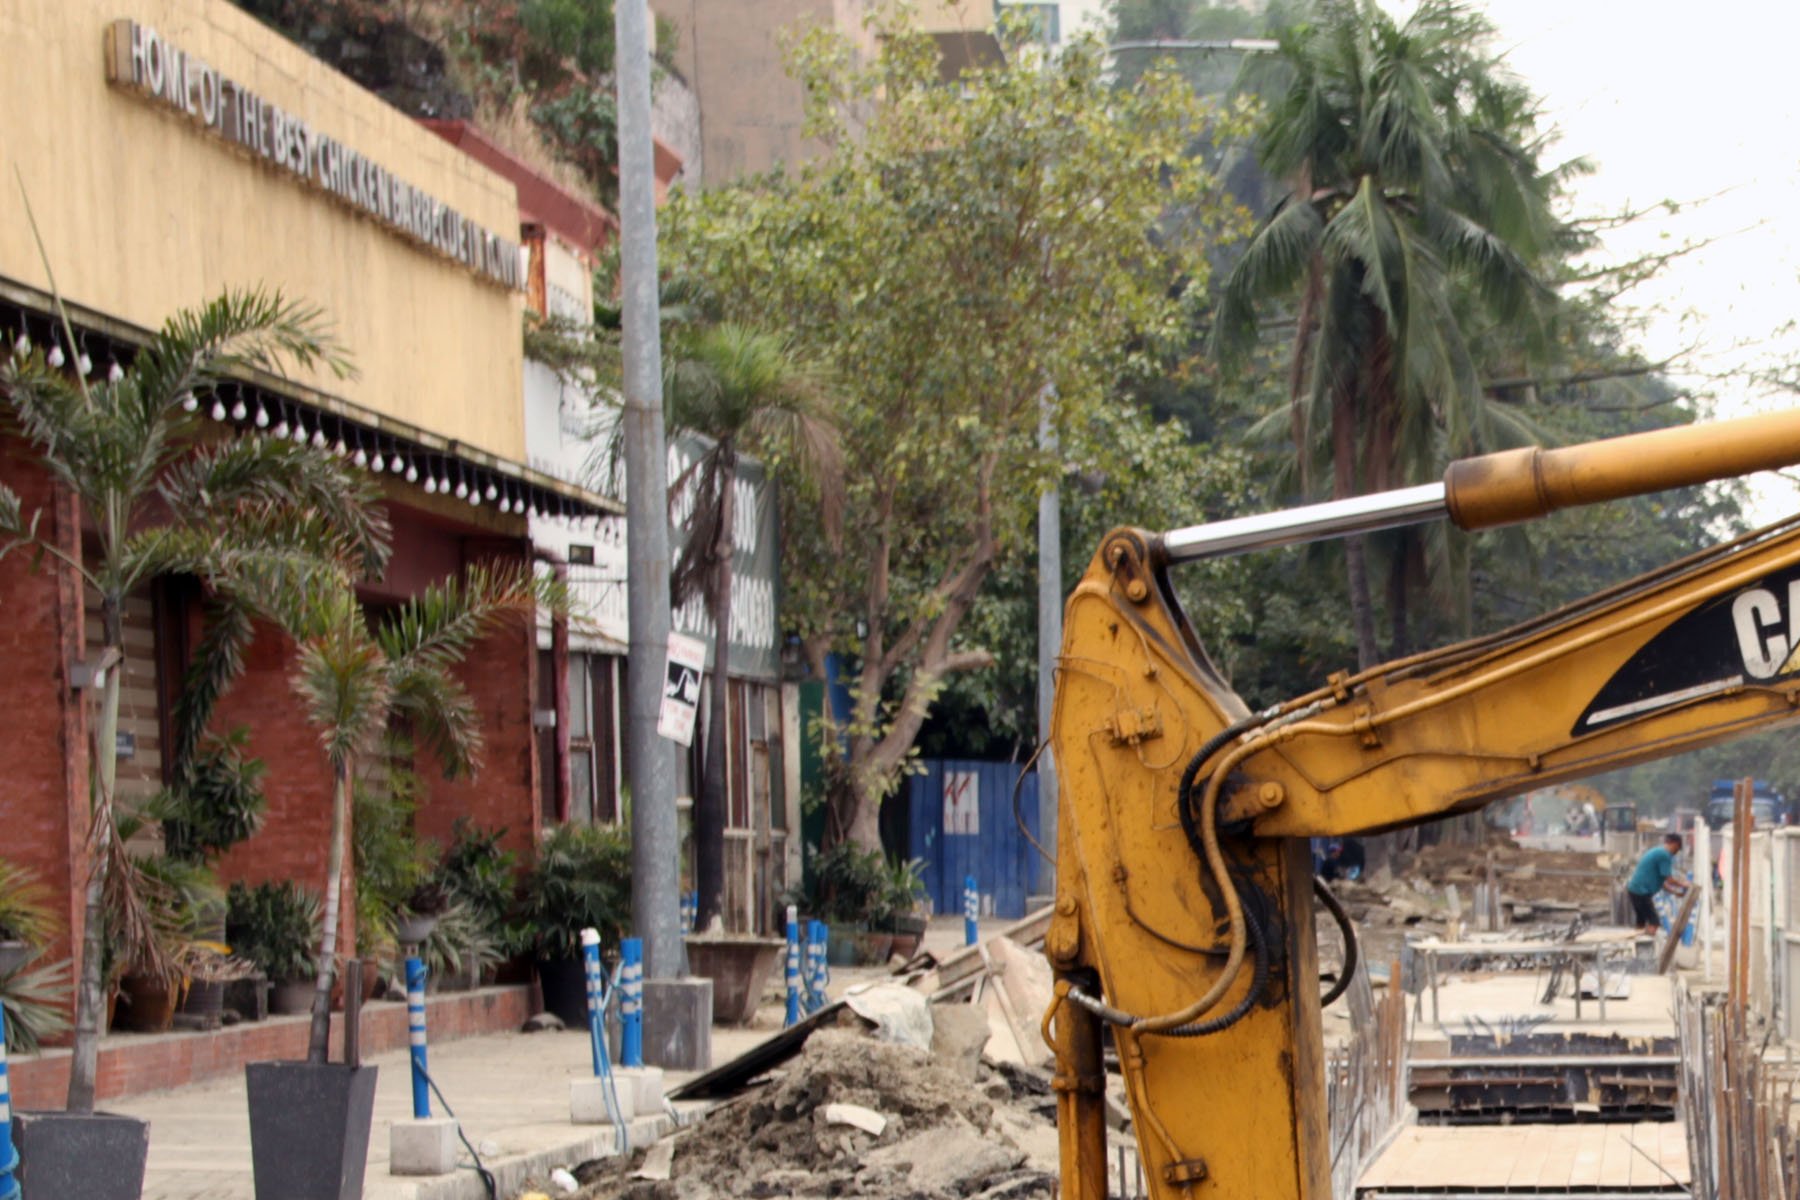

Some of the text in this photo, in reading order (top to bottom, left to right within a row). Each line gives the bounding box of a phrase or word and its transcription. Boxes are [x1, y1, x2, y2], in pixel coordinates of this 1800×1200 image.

[132, 23, 529, 292] HOME OF THE BEST CHICKEN BARBECUE IN TOWN
